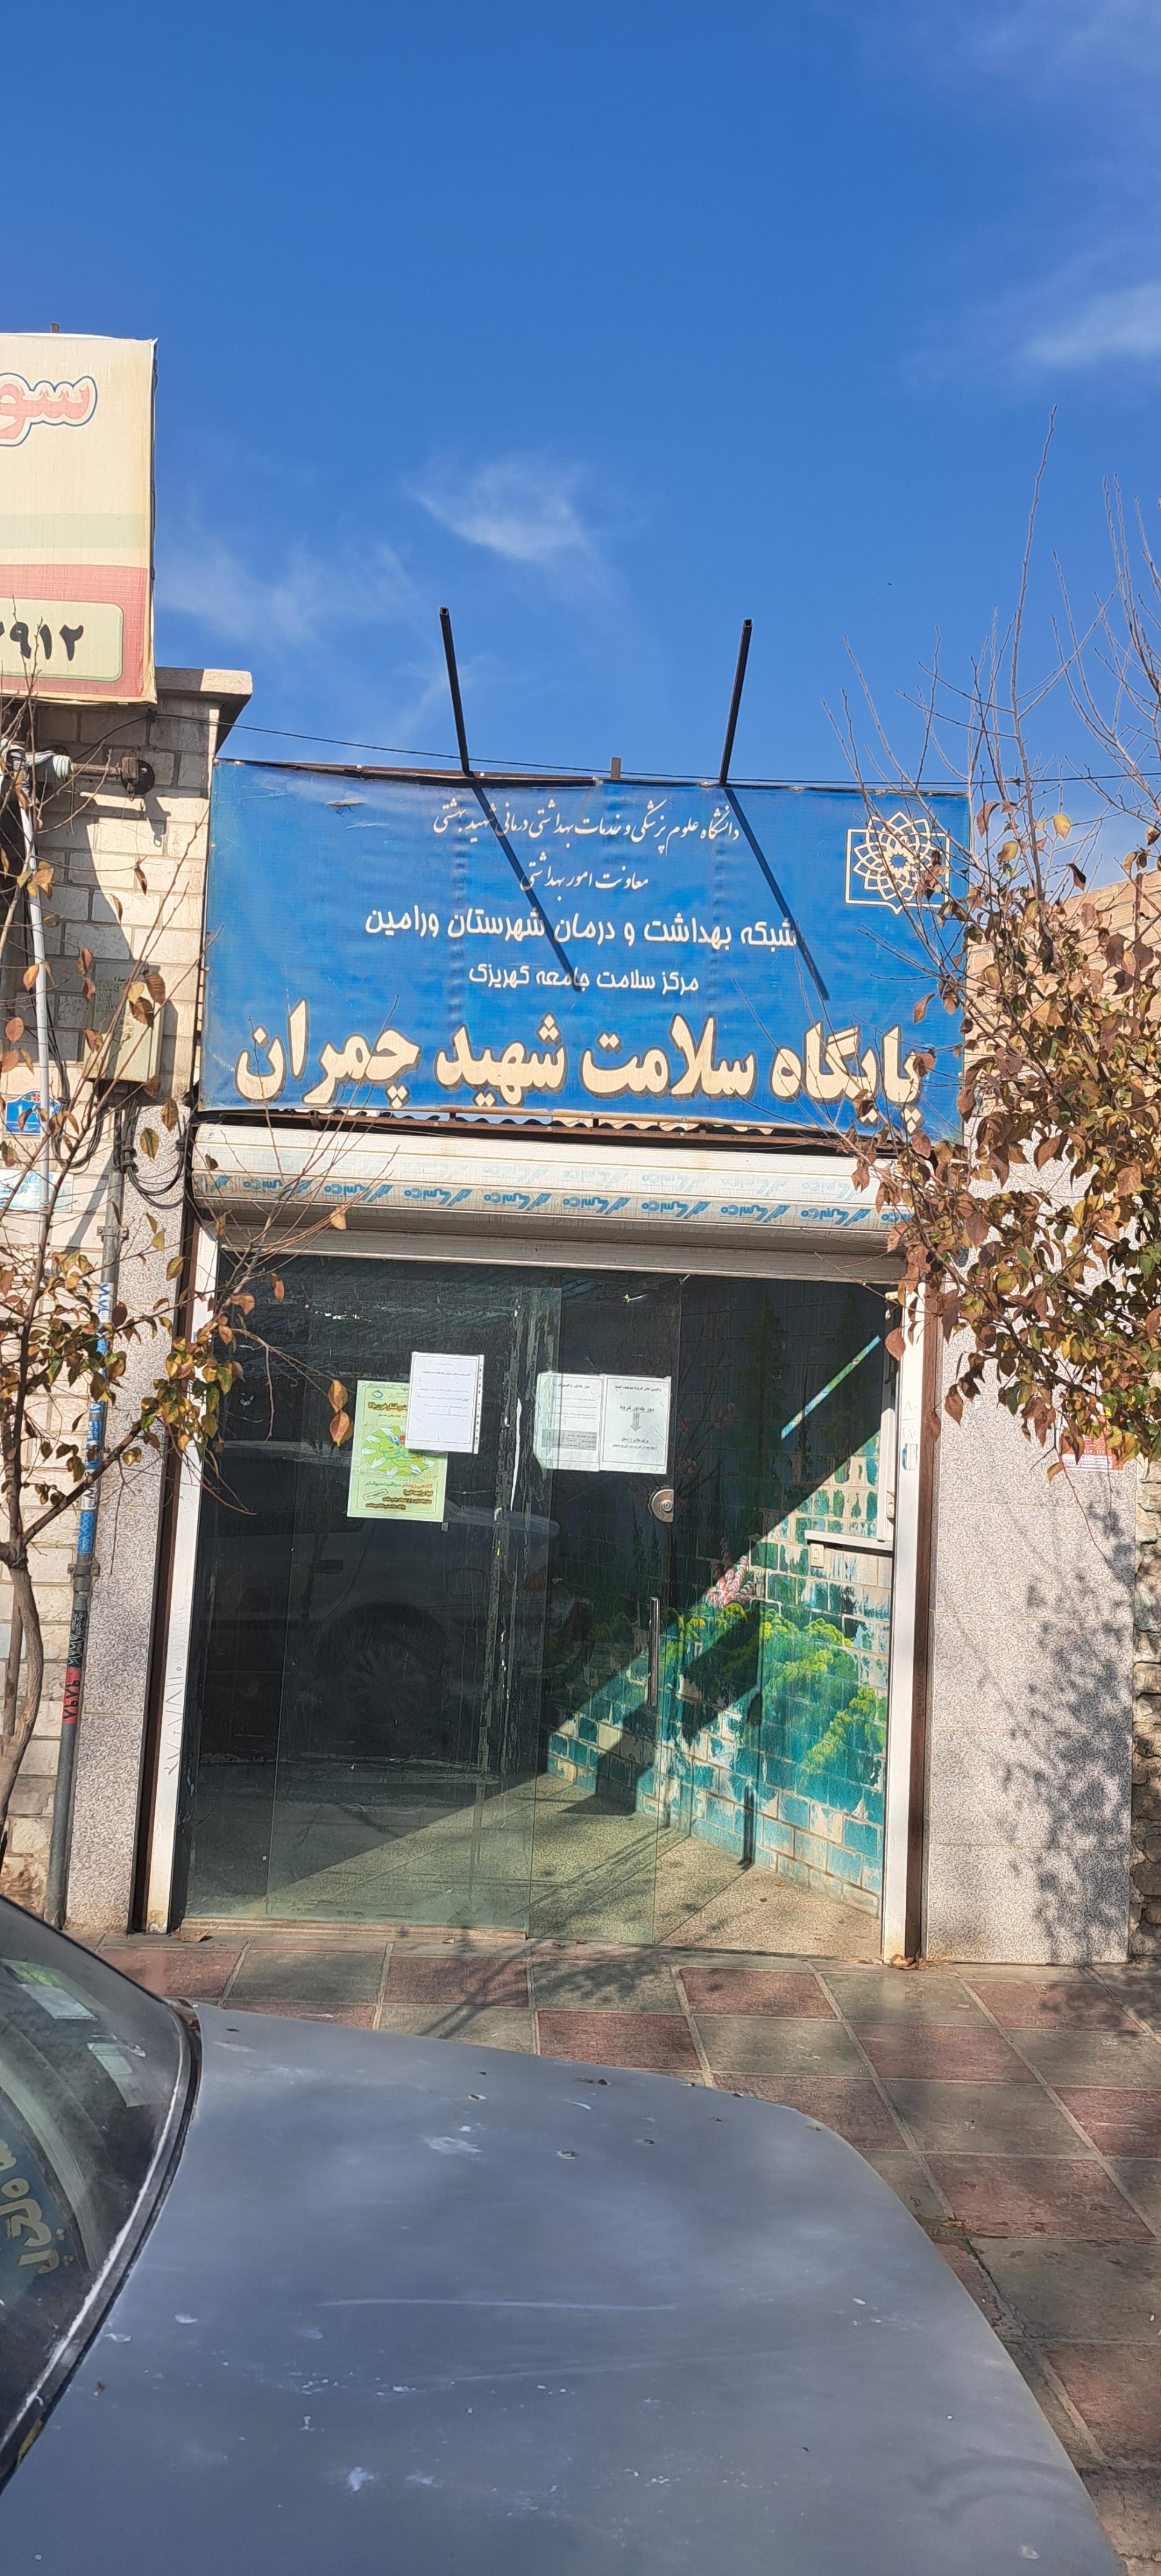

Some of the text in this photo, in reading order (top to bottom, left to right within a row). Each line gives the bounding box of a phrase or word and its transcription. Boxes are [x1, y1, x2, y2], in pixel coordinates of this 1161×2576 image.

[0, 621, 84, 661] ۹۱۲
[433, 797, 740, 855] دانشگاه علوم پزشکی و خدمات بهداشتی درمانی شهید بهشتی
[519, 851, 649, 901] معاونت امور بهداشتی
[365, 905, 797, 952] شبکه بهداشت و درمان شهرستان ورامین
[469, 963, 699, 996] مرکز سلامت جامعه کهریزک
[235, 998, 925, 1131] پایگاه سلامت شهید چمران
